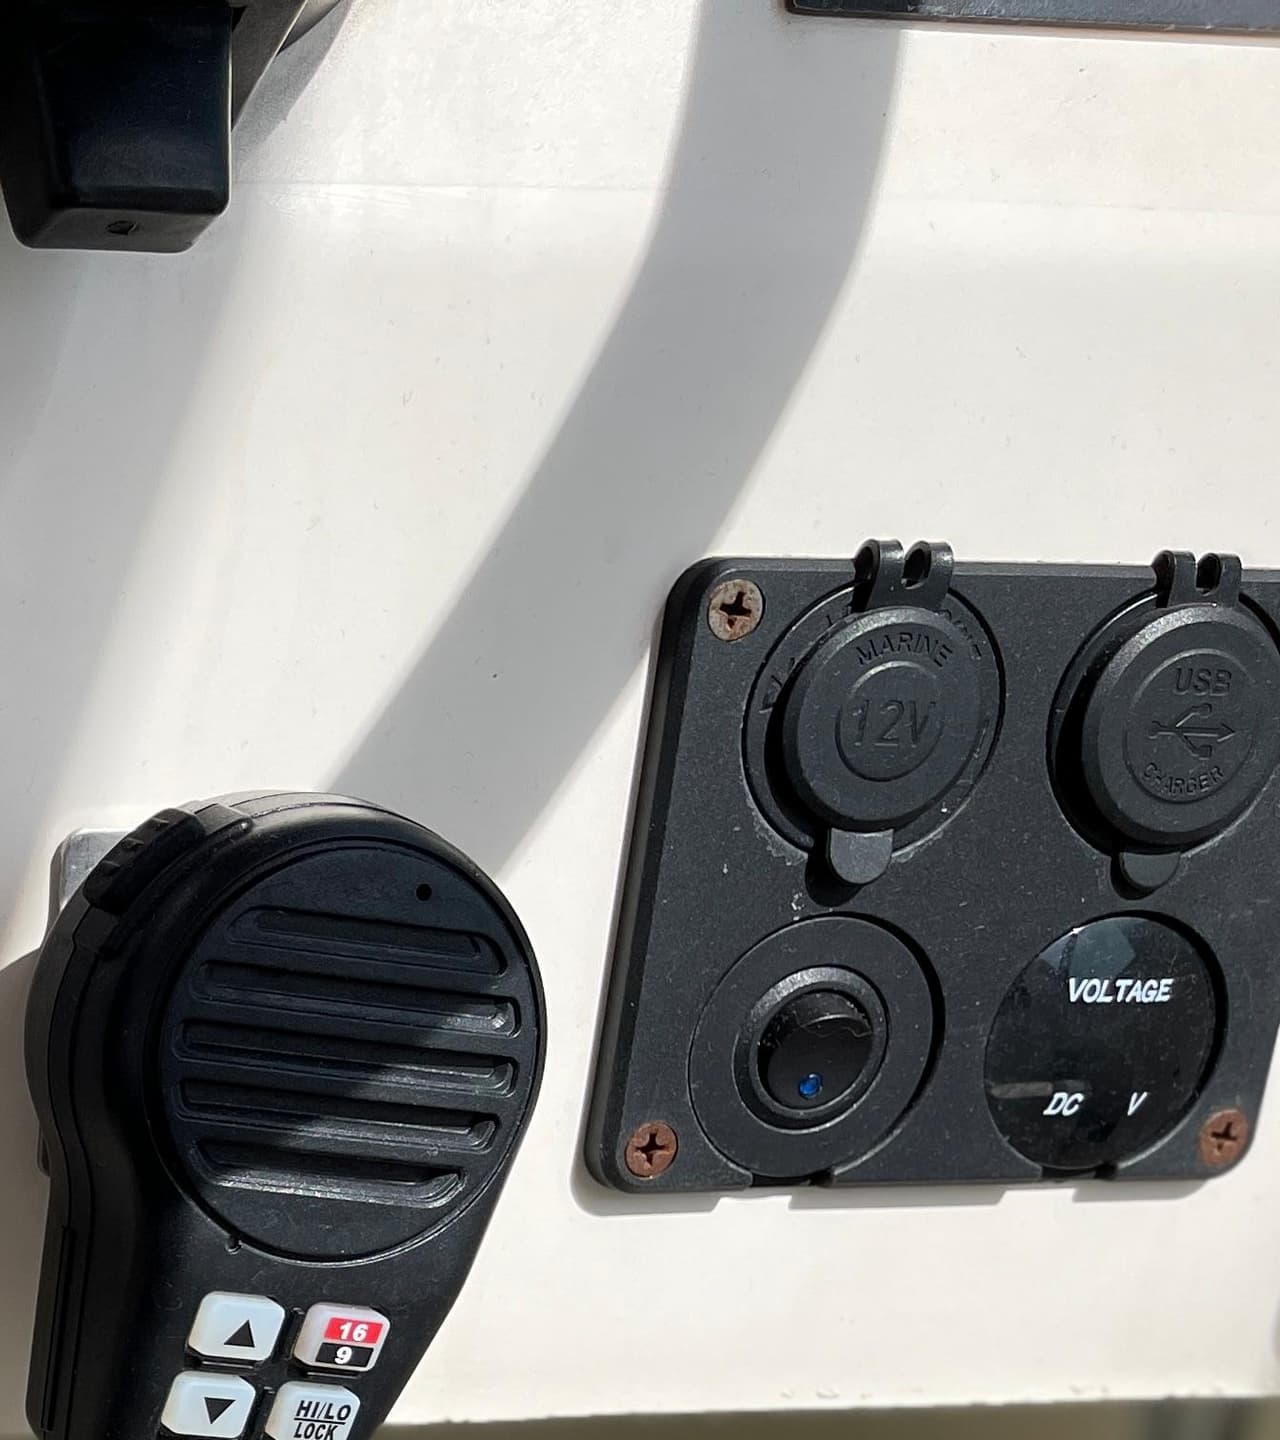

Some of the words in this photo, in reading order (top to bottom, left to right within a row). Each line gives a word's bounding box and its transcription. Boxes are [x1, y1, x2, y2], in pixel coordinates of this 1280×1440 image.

[855, 631, 954, 668] MARINE
[1175, 668, 1233, 695] USB
[850, 699, 938, 746] 12V
[1143, 762, 1224, 795] CHARGER
[1067, 977, 1173, 1004] VOLTAGE
[1043, 1091, 1085, 1116] DC
[1127, 1091, 1148, 1116] V
[339, 1322, 369, 1343] 16
[334, 1346, 352, 1364] 9
[295, 1400, 351, 1421] HI/LO
[293, 1422, 338, 1440] LOCK
